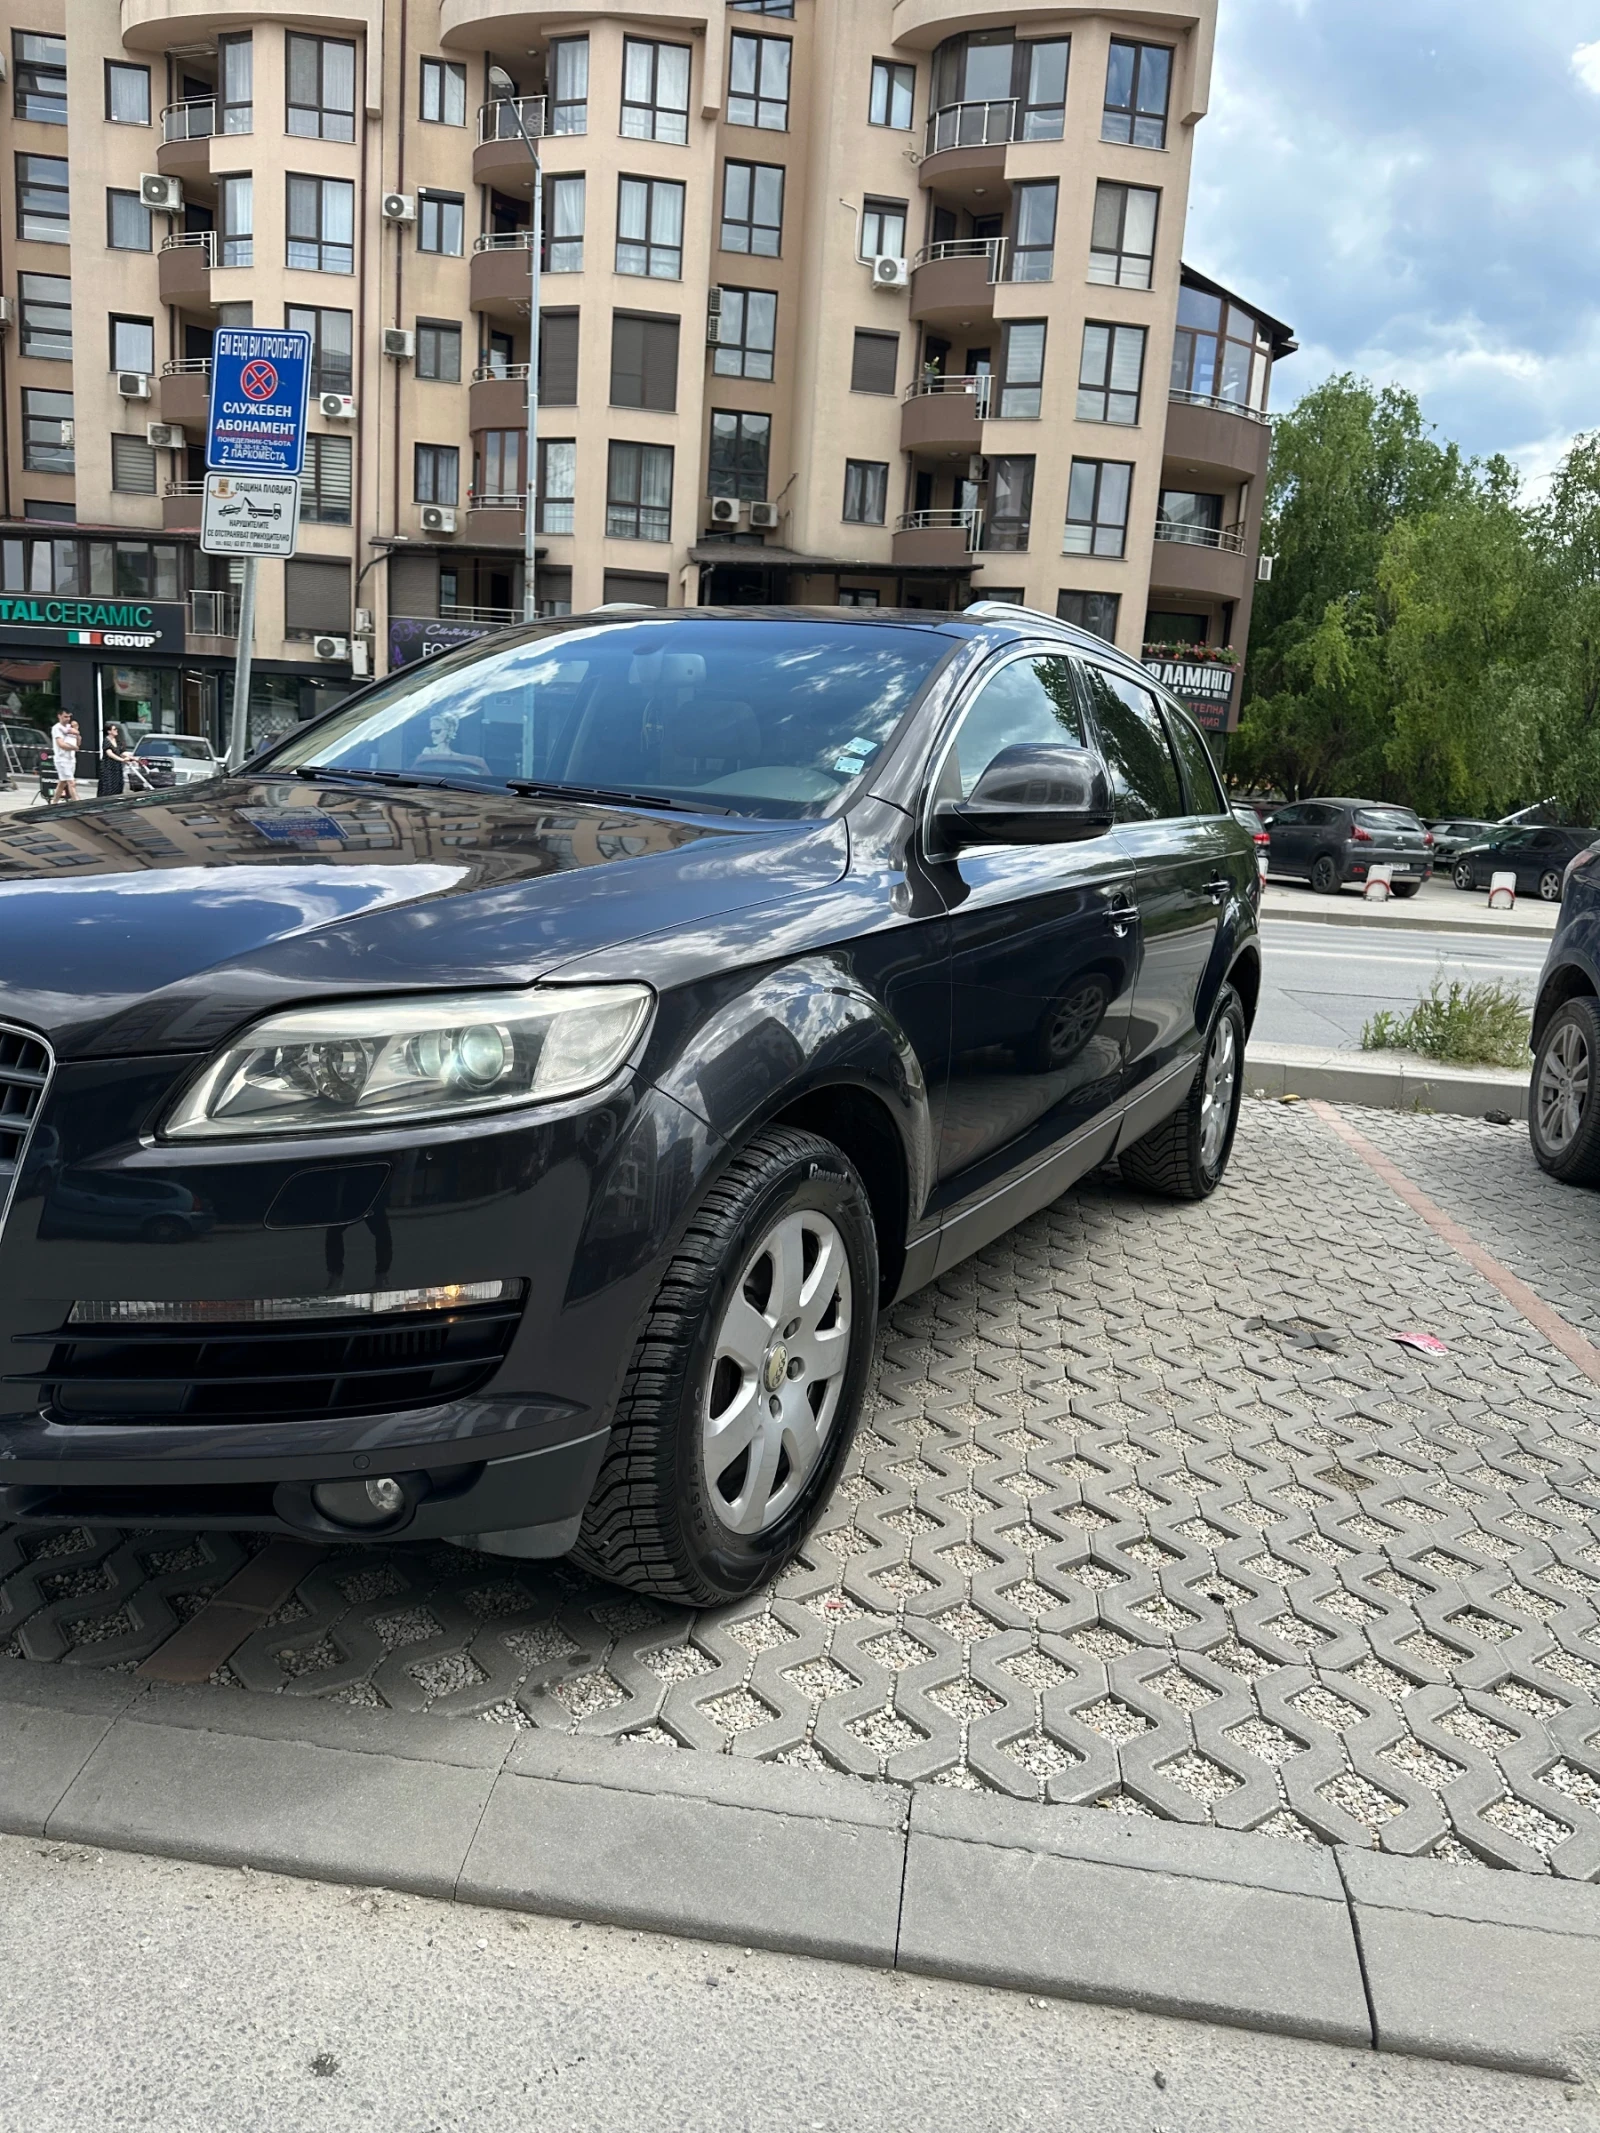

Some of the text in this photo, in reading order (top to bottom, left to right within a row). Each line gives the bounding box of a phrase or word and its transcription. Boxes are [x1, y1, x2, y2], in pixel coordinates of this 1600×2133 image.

[220, 334, 303, 360] ЕМ ЕНД ВИ ПРОПЪРТИ
[222, 401, 292, 418] СЛУЖЕБЕН
[216, 419, 297, 435] АБОНАМЕНТ
[222, 445, 286, 461] 2 ПАРКОМЕСТА
[235, 482, 293, 495] ОБЩИНА ПЛОВДИВ
[229, 520, 269, 529] НАРУШИТЕЛИТЕ
[0, 600, 152, 627] TALCERAMIC
[104, 634, 155, 648] GROUP
[1145, 663, 1232, 692] ФЛАМИНГО
[1172, 686, 1211, 697] ГРУП
